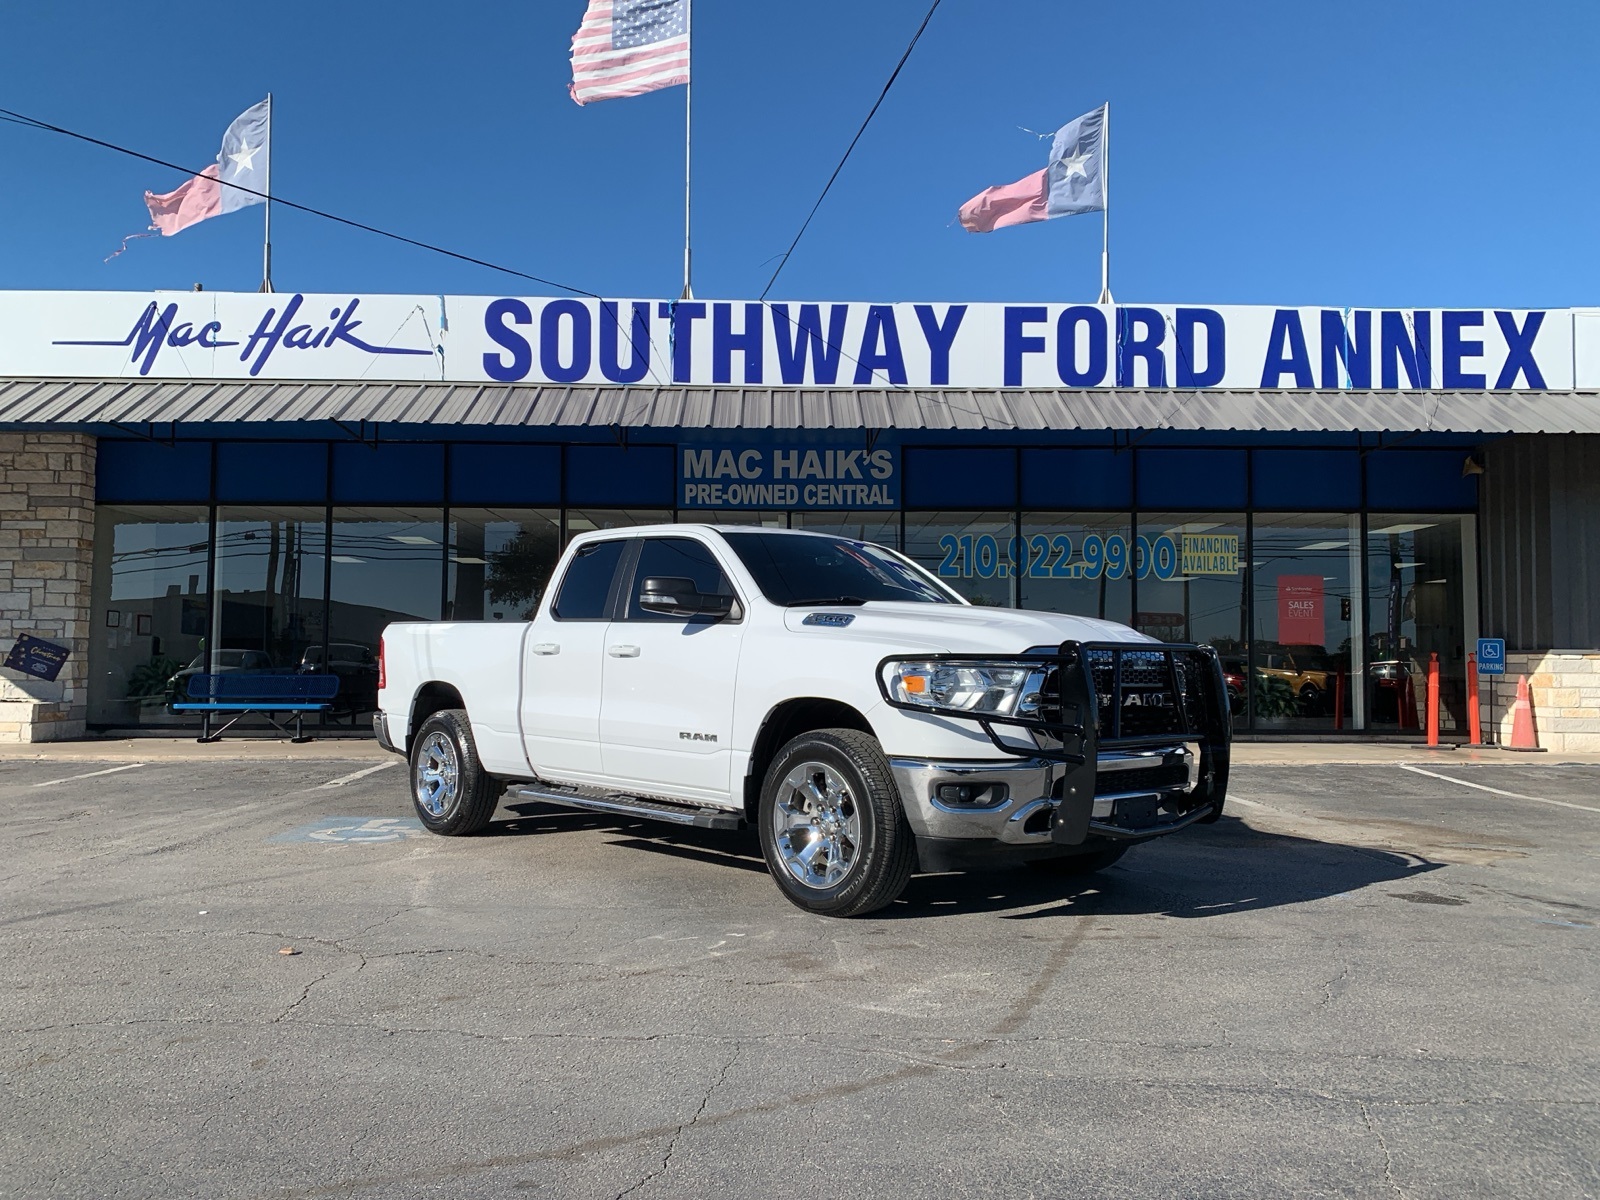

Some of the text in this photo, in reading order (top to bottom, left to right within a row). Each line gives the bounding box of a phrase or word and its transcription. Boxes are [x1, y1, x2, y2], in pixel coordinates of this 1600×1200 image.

[53, 294, 432, 375] Mac Haik
[483, 298, 1547, 391] SOUTHWAY FORD ANNEX
[683, 449, 894, 479] MAC HAIK'S
[684, 483, 894, 505] PRE-OWNED CENTRAL
[1183, 537, 1237, 554] FINANCING
[938, 534, 1177, 580] 210.922.9900
[1183, 555, 1237, 572] AVAILABLE
[1288, 601, 1314, 609] SALES
[1288, 609, 1313, 618] EVENT
[1479, 663, 1504, 671] PARKING
[679, 732, 718, 742] RAM
